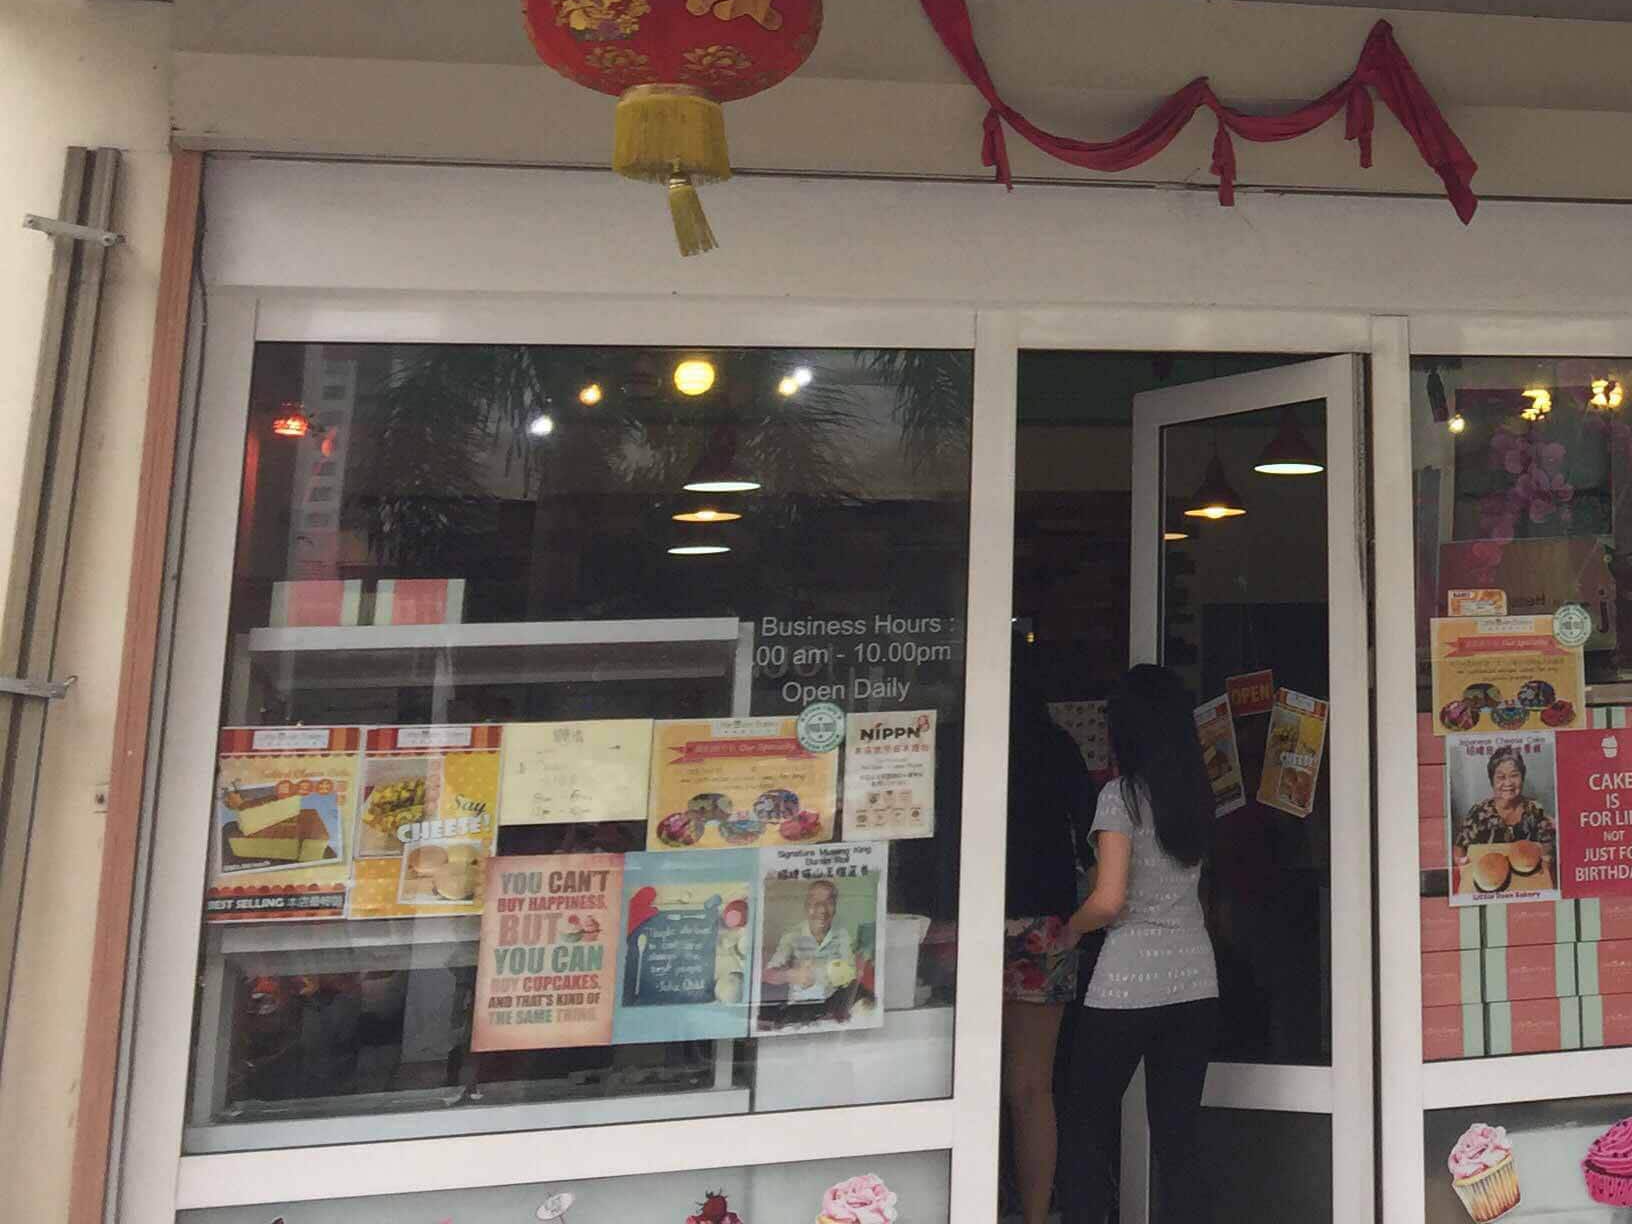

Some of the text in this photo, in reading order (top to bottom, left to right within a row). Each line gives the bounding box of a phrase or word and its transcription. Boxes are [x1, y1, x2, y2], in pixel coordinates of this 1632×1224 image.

[761, 616, 867, 637] Business
[873, 614, 942, 635] Hours
[792, 648, 829, 665] am
[853, 641, 951, 665] 10.00pm
[782, 677, 911, 706] Open Daily
[1605, 793, 1621, 809] IS
[1580, 811, 1613, 828] FOR
[1603, 830, 1626, 842] NOT
[1584, 847, 1617, 862] JUST
[501, 869, 610, 895] YOU CAN'T
[236, 896, 286, 909] SELLING
[497, 897, 525, 912] BUY
[498, 912, 563, 946] BUT
[494, 944, 605, 975] YOU CAN
[487, 995, 513, 1009] AND
[556, 992, 585, 1006] KIND
[586, 991, 601, 1005] OF
[515, 1008, 553, 1024] SAME
